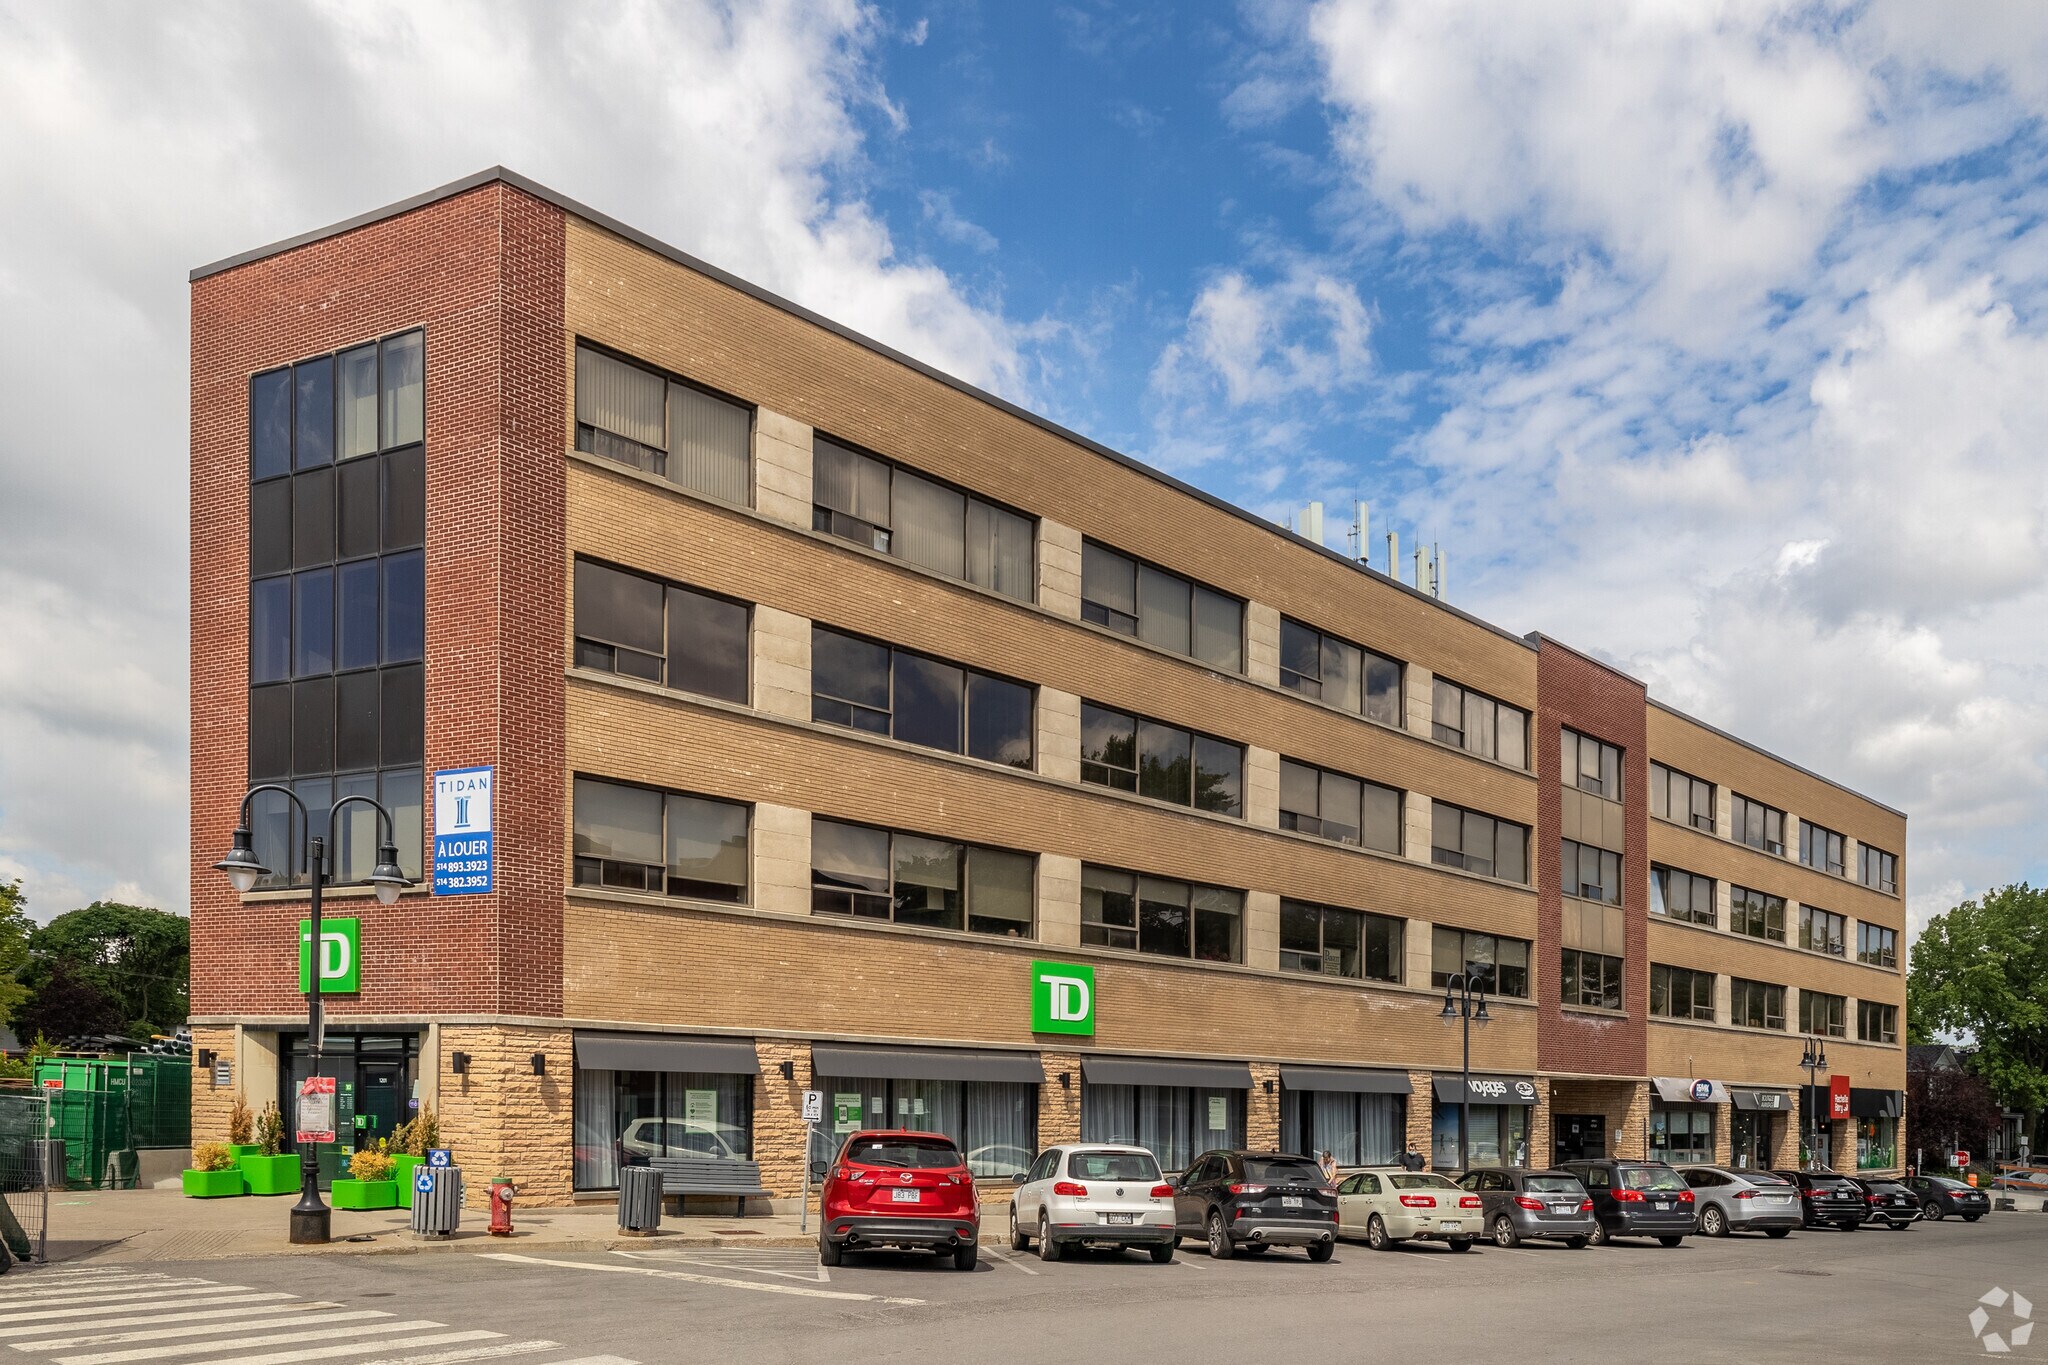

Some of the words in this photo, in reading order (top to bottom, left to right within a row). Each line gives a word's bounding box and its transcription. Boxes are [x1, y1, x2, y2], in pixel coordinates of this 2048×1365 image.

[439, 778, 487, 793] TIDAN
[438, 841, 446, 857] À
[448, 840, 488, 857] LOUER
[436, 862, 447, 871] 514
[447, 860, 488, 873] 893.3923
[436, 878, 447, 886] 514
[448, 875, 488, 888] 382.3952
[303, 932, 350, 978] D
[1040, 974, 1090, 1022] TD
[110, 1078, 126, 1086] HMCU
[808, 1094, 817, 1105] P
